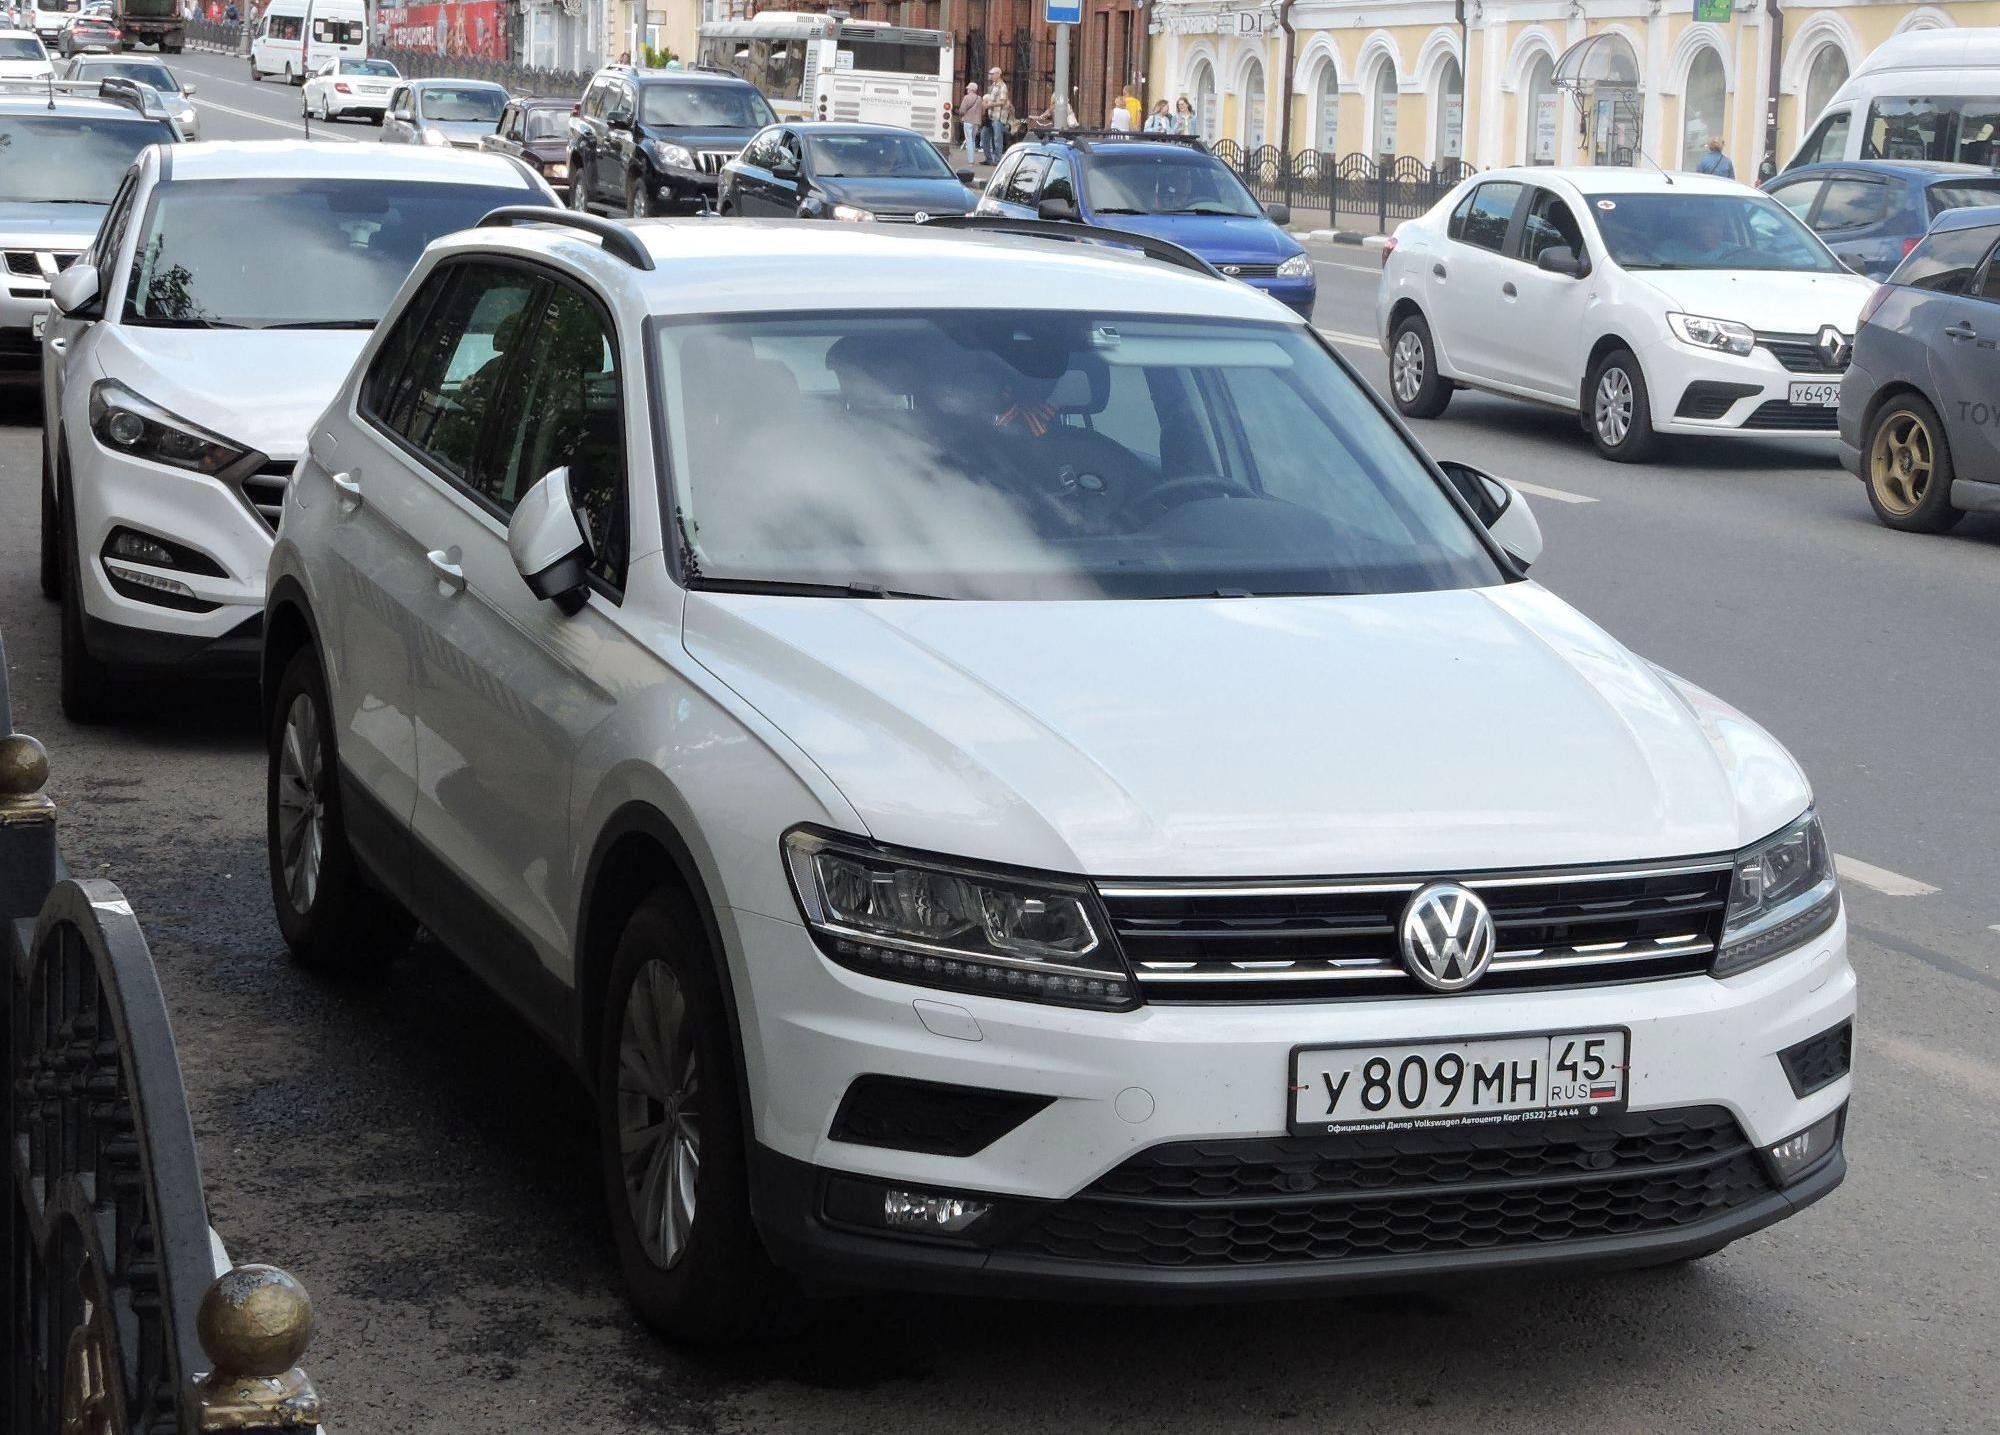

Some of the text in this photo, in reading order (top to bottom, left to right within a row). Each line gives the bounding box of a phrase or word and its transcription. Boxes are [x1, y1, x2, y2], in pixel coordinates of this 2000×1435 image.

[1556, 1039, 1606, 1082] 45
[1551, 1083, 1587, 1100] RUS
[1327, 1121, 1386, 1133] Официальный
[1387, 1121, 1413, 1130] Дилер
[1414, 1118, 1460, 1128] Volkswagen
[1461, 1115, 1502, 1125] Автоцентр
[1522, 1110, 1546, 1121] (3522)
